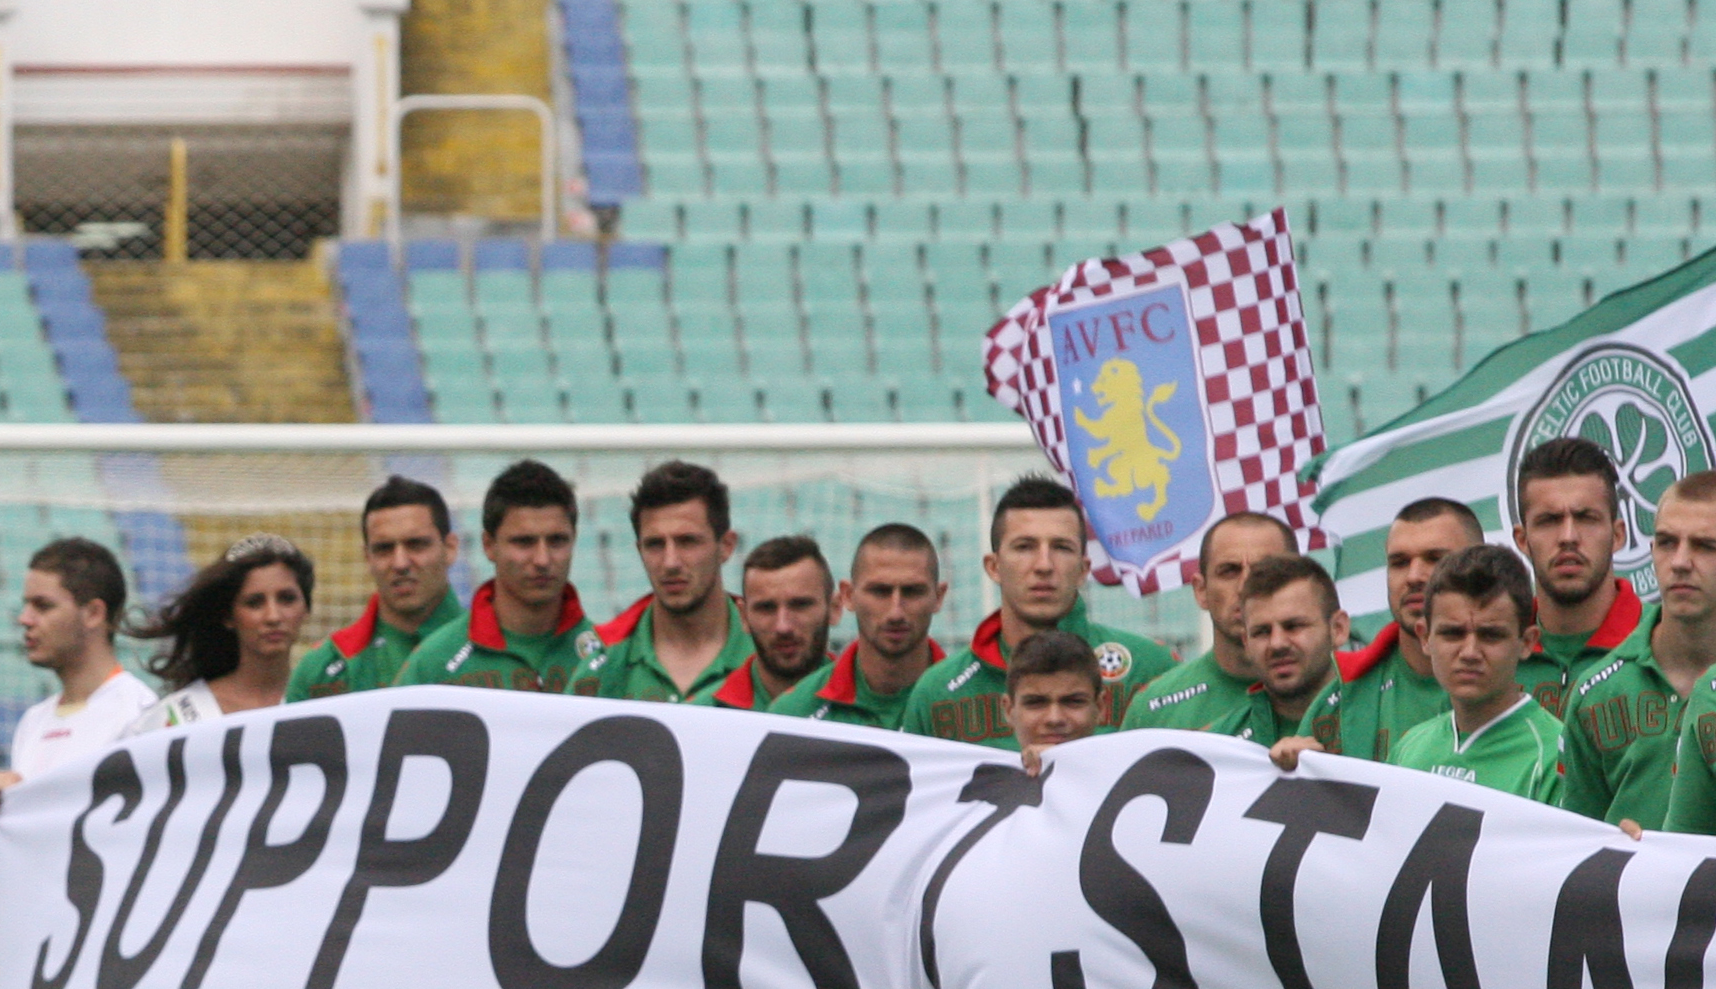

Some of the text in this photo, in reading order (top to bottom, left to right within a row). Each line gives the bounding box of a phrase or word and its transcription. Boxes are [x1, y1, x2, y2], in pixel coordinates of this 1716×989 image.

[1062, 302, 1175, 366] AVFC
[1578, 357, 1663, 399] FOOTBALL
[1666, 390, 1698, 449] CLUB
[1629, 562, 1658, 595] 188
